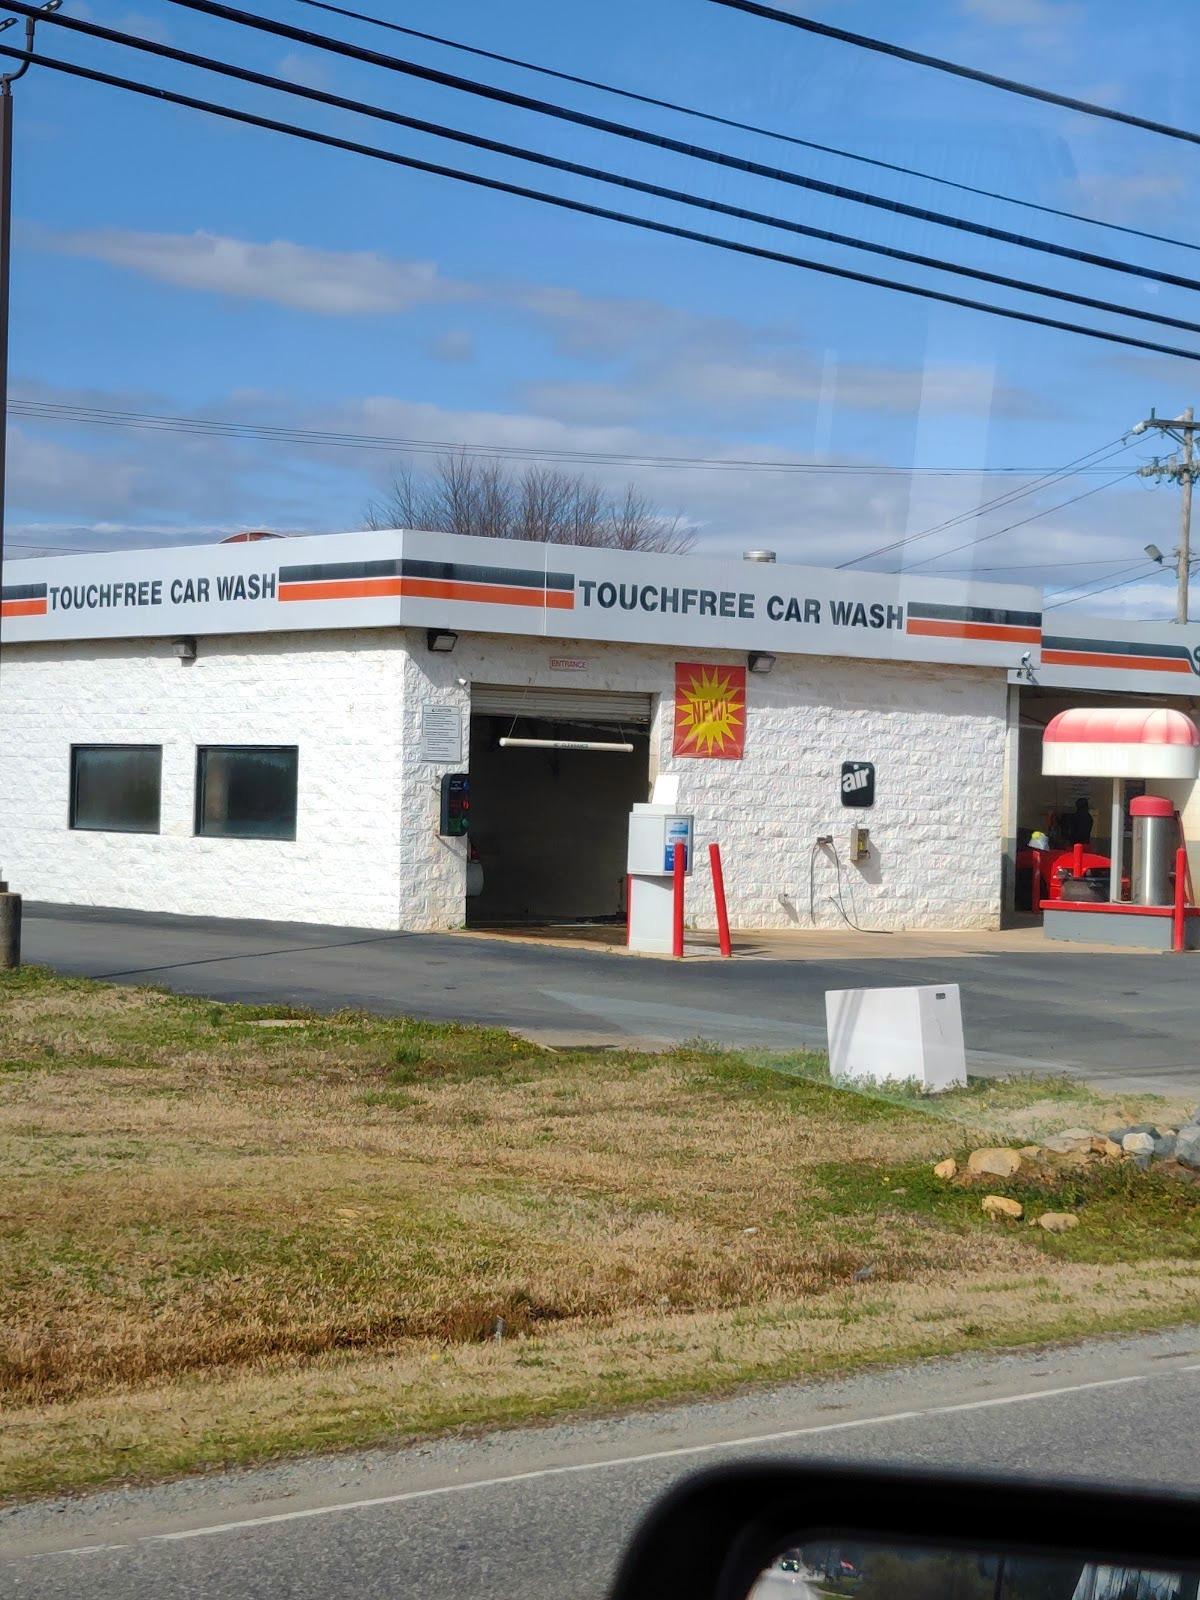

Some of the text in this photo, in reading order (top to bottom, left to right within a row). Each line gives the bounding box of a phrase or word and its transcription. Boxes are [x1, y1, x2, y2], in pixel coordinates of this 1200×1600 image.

[50, 573, 276, 610] TOUCHFREE CAR WASH
[579, 580, 903, 630] TOUCHFREE CAR WASH
[842, 764, 870, 793] air
